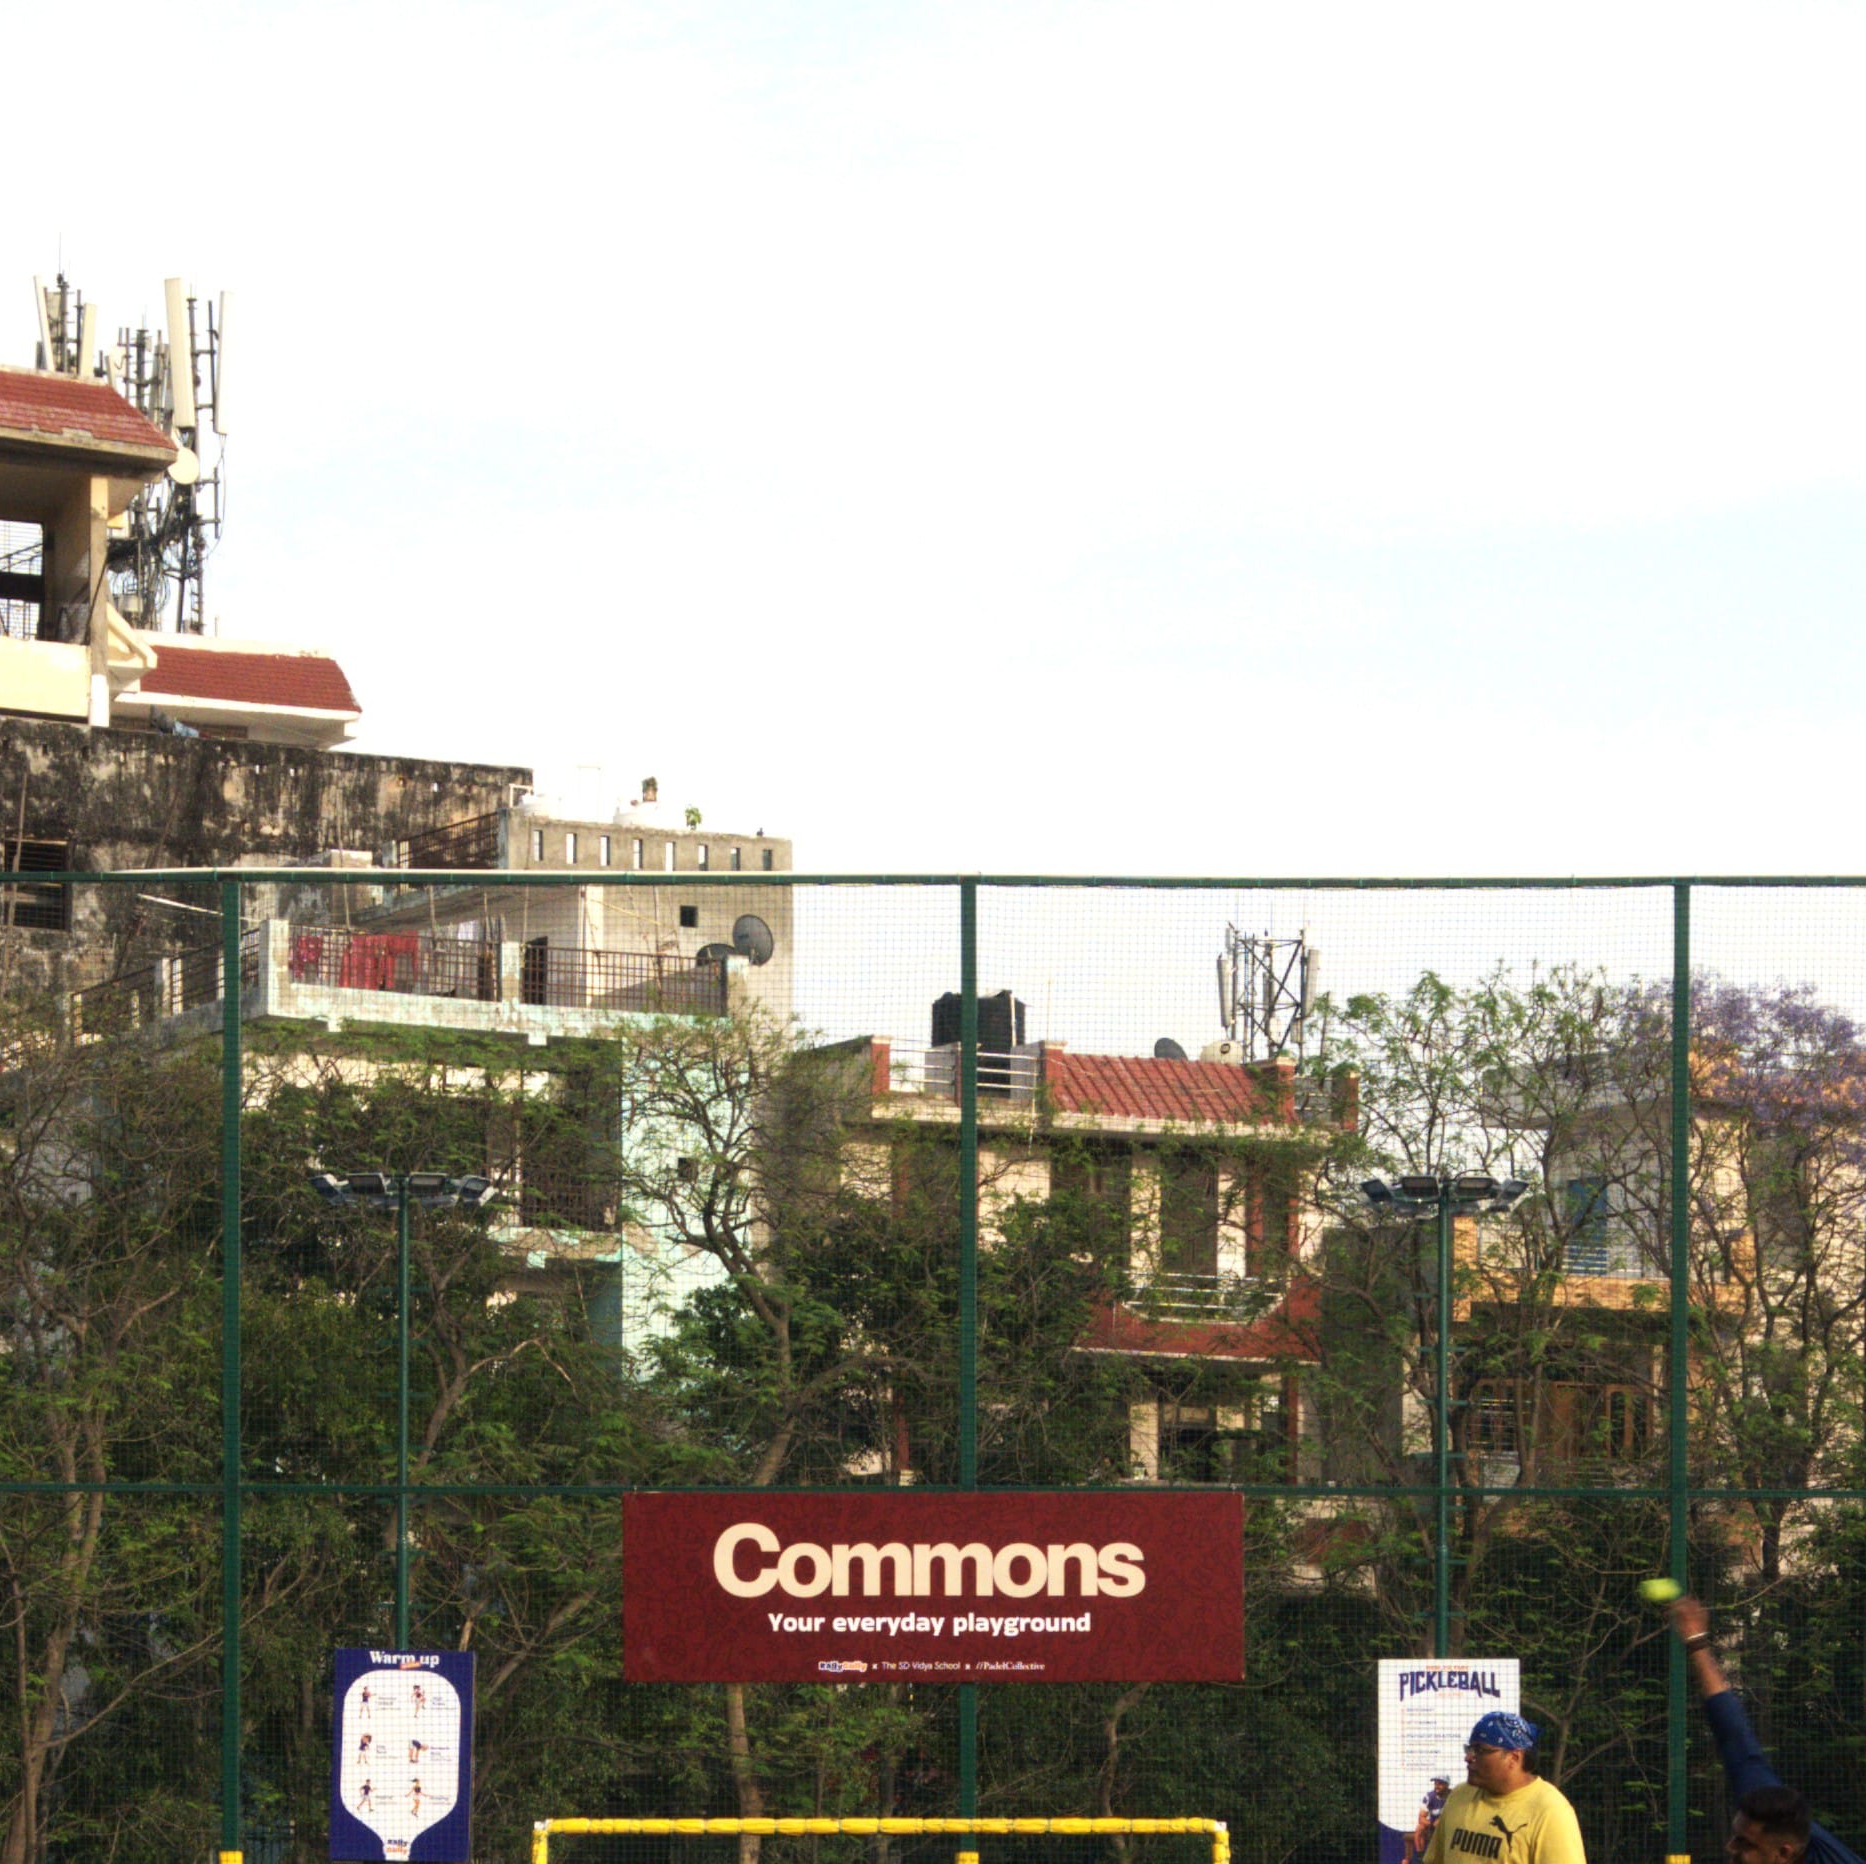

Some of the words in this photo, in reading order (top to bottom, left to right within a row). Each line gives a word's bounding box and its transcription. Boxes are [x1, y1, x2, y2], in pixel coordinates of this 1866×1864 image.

[713, 1522, 1146, 1598] Commons
[768, 1613, 825, 1632] Your
[832, 1613, 945, 1637] everyday
[953, 1612, 1091, 1637] playground
[369, 1650, 415, 1665] Warm
[420, 1655, 440, 1668] up
[881, 1661, 897, 1670] The
[912, 1661, 933, 1672] Vidya
[934, 1661, 961, 1671] School
[1398, 1671, 1501, 1702] PICKLEBALL
[1450, 1828, 1503, 1860] PUMA
